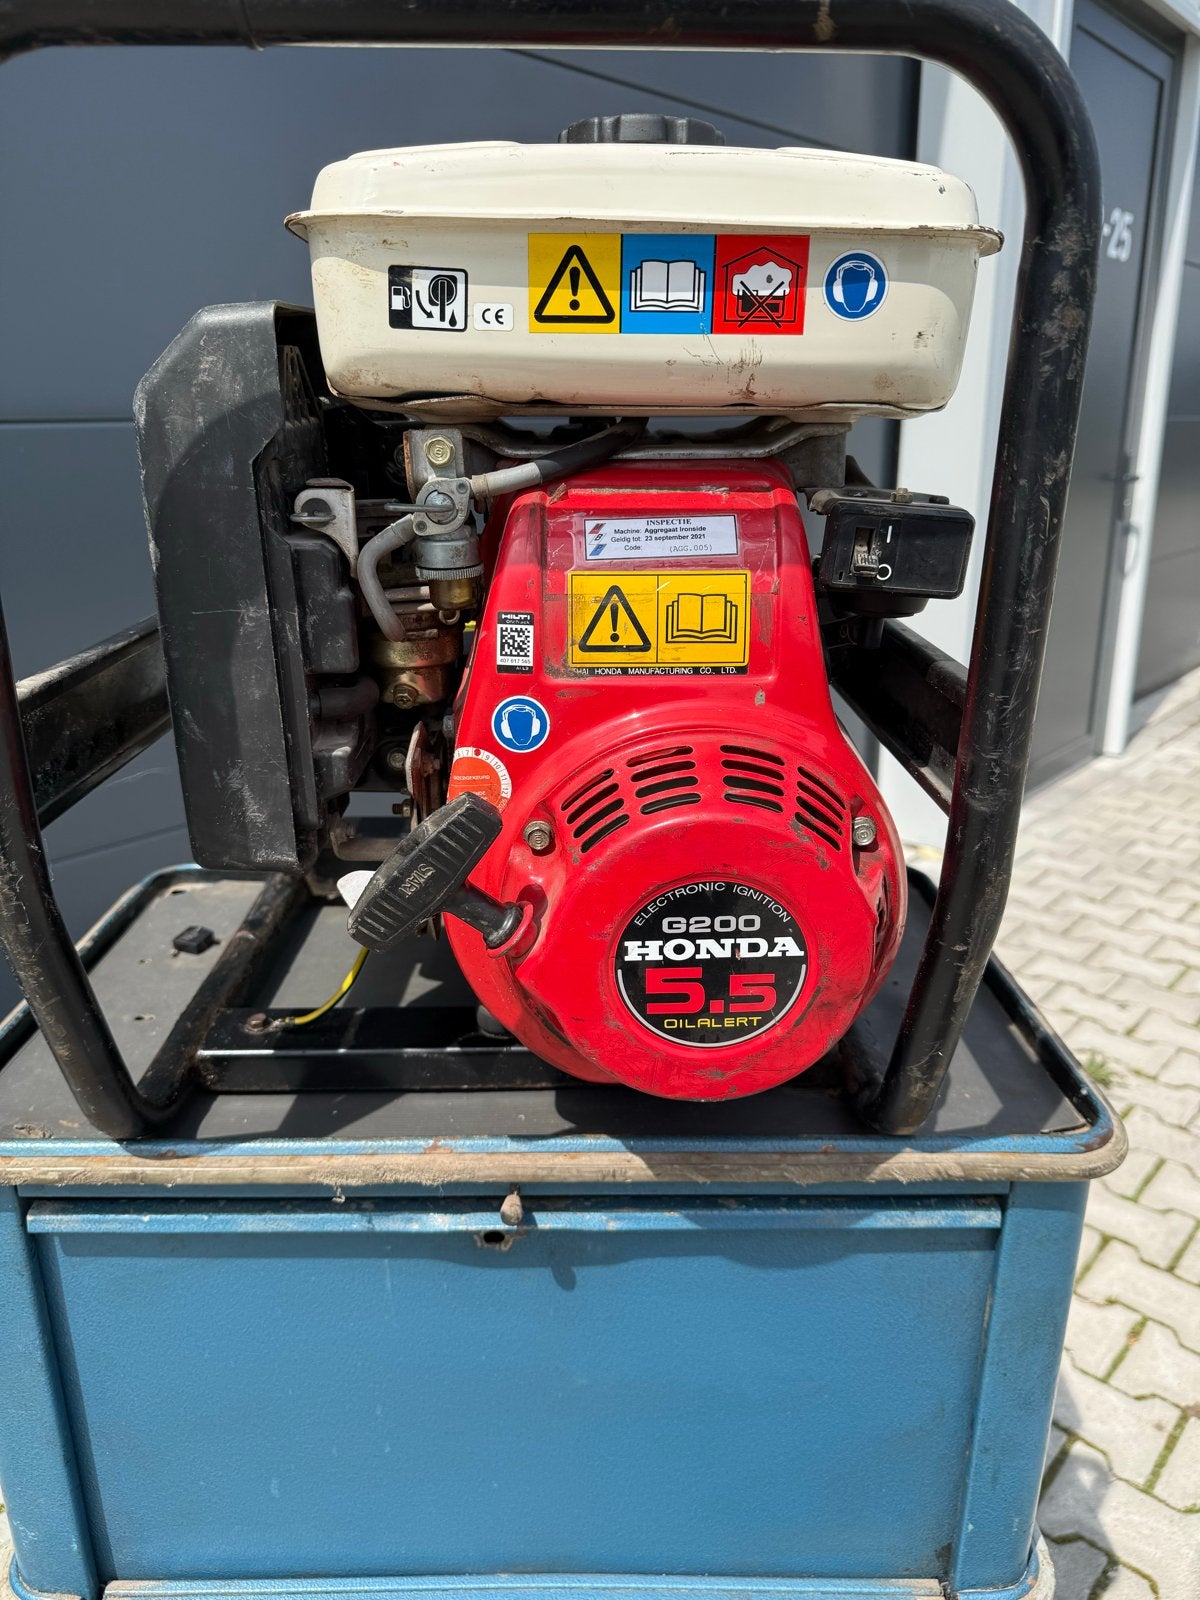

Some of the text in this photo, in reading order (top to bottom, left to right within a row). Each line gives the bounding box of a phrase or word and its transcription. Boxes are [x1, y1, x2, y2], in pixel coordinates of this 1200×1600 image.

[481, 308, 504, 325] CE
[646, 518, 692, 526] INSPECTIE
[644, 526, 678, 535] Aggregaat
[679, 525, 707, 533] Ironside
[610, 536, 631, 544] Geldig
[654, 534, 689, 542] september
[669, 544, 713, 553] (AGG.005)
[594, 667, 622, 675] HONDA
[628, 666, 693, 675] MANUFACTURING
[721, 666, 737, 674] LTD.
[493, 761, 502, 770] 10
[634, 882, 792, 927] ELECTRONIC IGNITION
[661, 914, 761, 934] G200
[624, 936, 805, 962] HONDA
[645, 966, 777, 1015] 5.5
